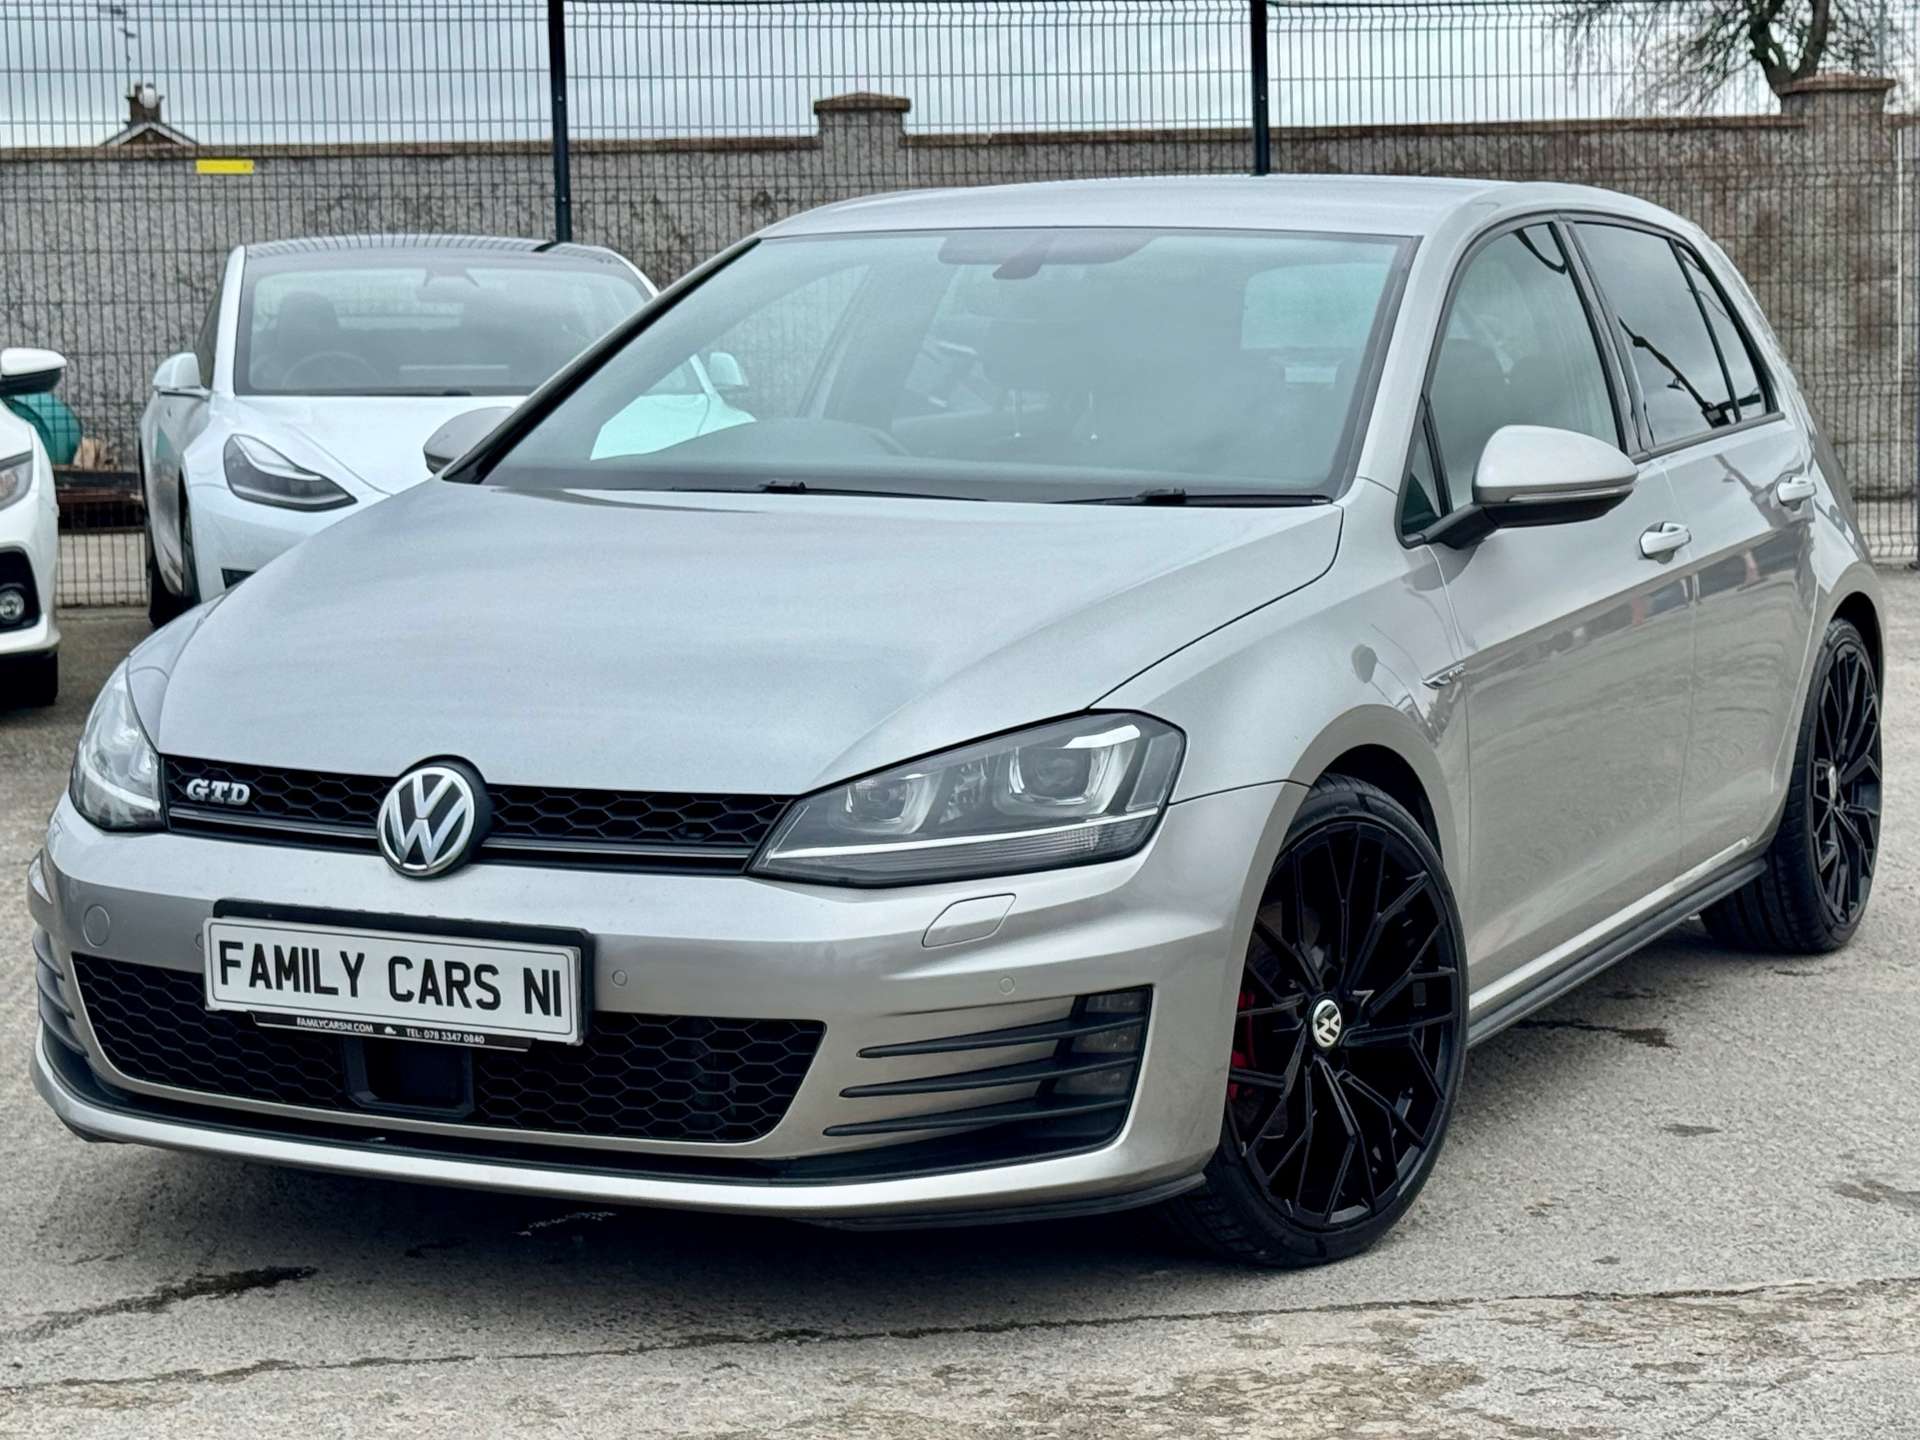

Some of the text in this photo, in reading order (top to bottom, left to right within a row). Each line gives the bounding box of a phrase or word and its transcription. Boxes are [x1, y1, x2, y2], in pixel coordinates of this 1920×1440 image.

[186, 777, 250, 806] GTD
[377, 766, 475, 877] VW
[218, 940, 365, 998] FAMILY
[388, 955, 502, 1010] CARS
[296, 1017, 374, 1033] FAMILYCARSNI.COM
[406, 1028, 422, 1038] TEL:
[423, 1029, 440, 1040] 078
[441, 1031, 462, 1042] 3347
